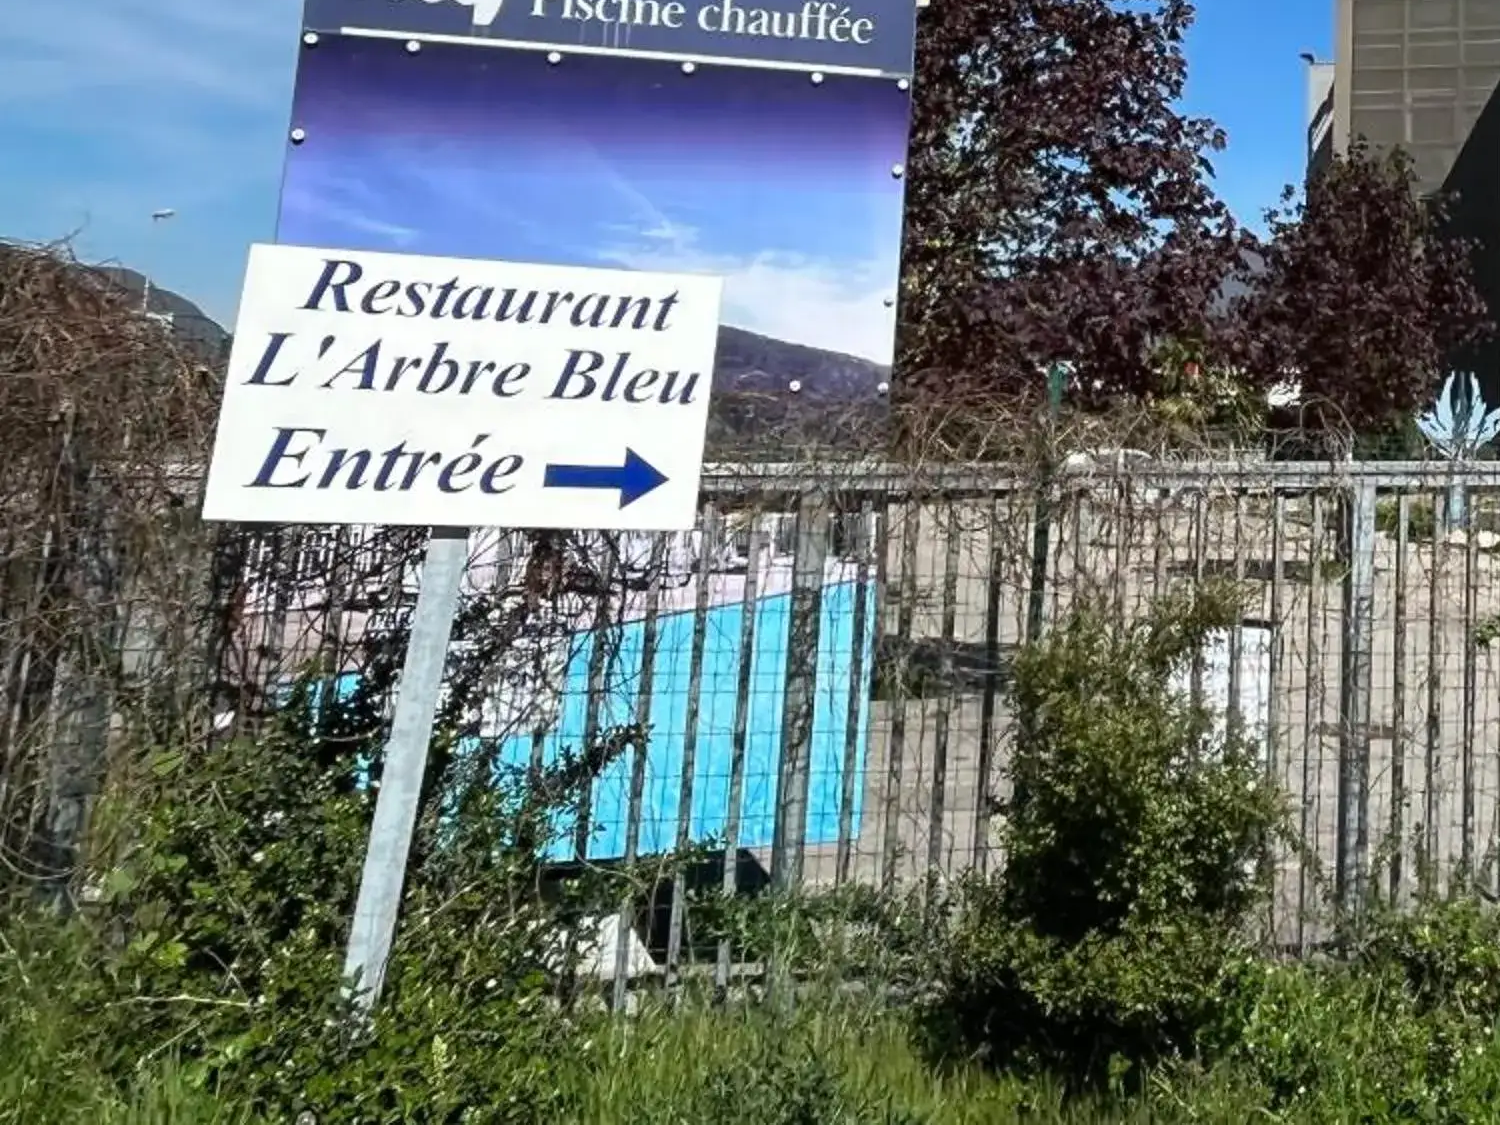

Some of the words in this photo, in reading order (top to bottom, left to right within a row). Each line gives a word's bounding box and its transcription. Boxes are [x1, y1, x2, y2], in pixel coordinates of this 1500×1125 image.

[296, 259, 680, 332] Restaurant
[241, 332, 531, 397] L'Arbre
[543, 348, 700, 405] Bleu
[242, 427, 524, 495] Entrée
